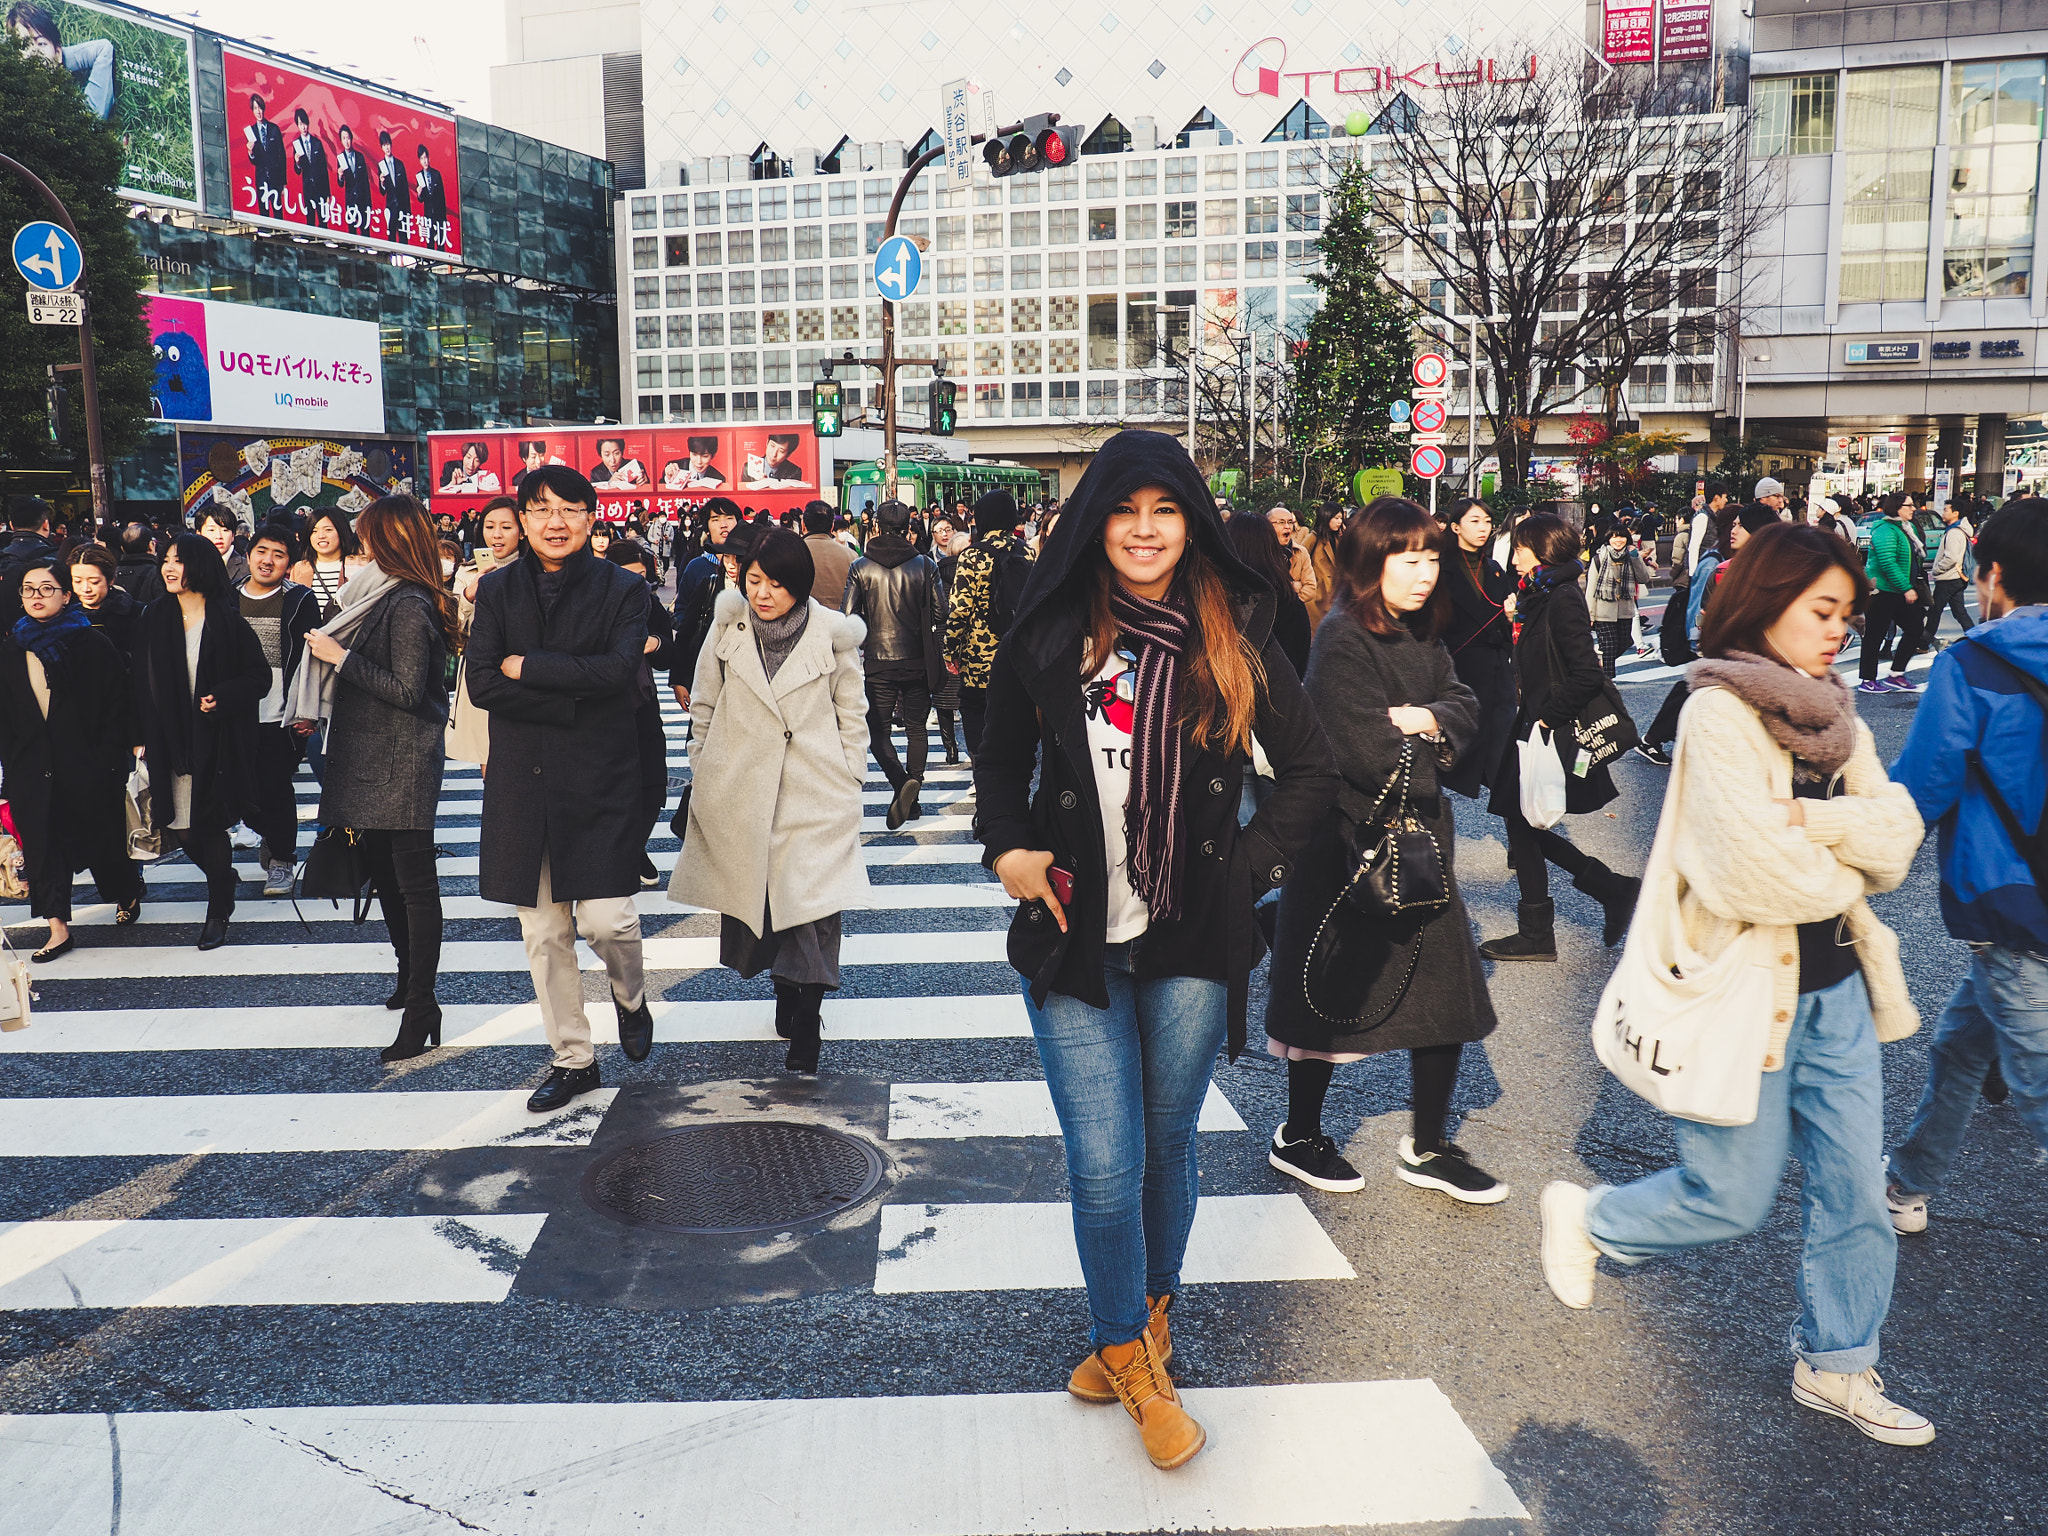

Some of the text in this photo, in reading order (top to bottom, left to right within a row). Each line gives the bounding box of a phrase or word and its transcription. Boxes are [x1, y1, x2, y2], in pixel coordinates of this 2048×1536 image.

[1607, 30, 1649, 39] カスタマー
[1607, 38, 1649, 47] センターへ
[122, 60, 163, 78] スマホがやっと
[1284, 55, 1536, 98] TOKYU
[946, 106, 954, 148] Shibuya
[953, 88, 969, 181] 渋谷駅前
[144, 168, 188, 189] SoftBank
[219, 350, 373, 384] UQモバイル、だぞっ
[275, 392, 328, 407] UQ mobile
